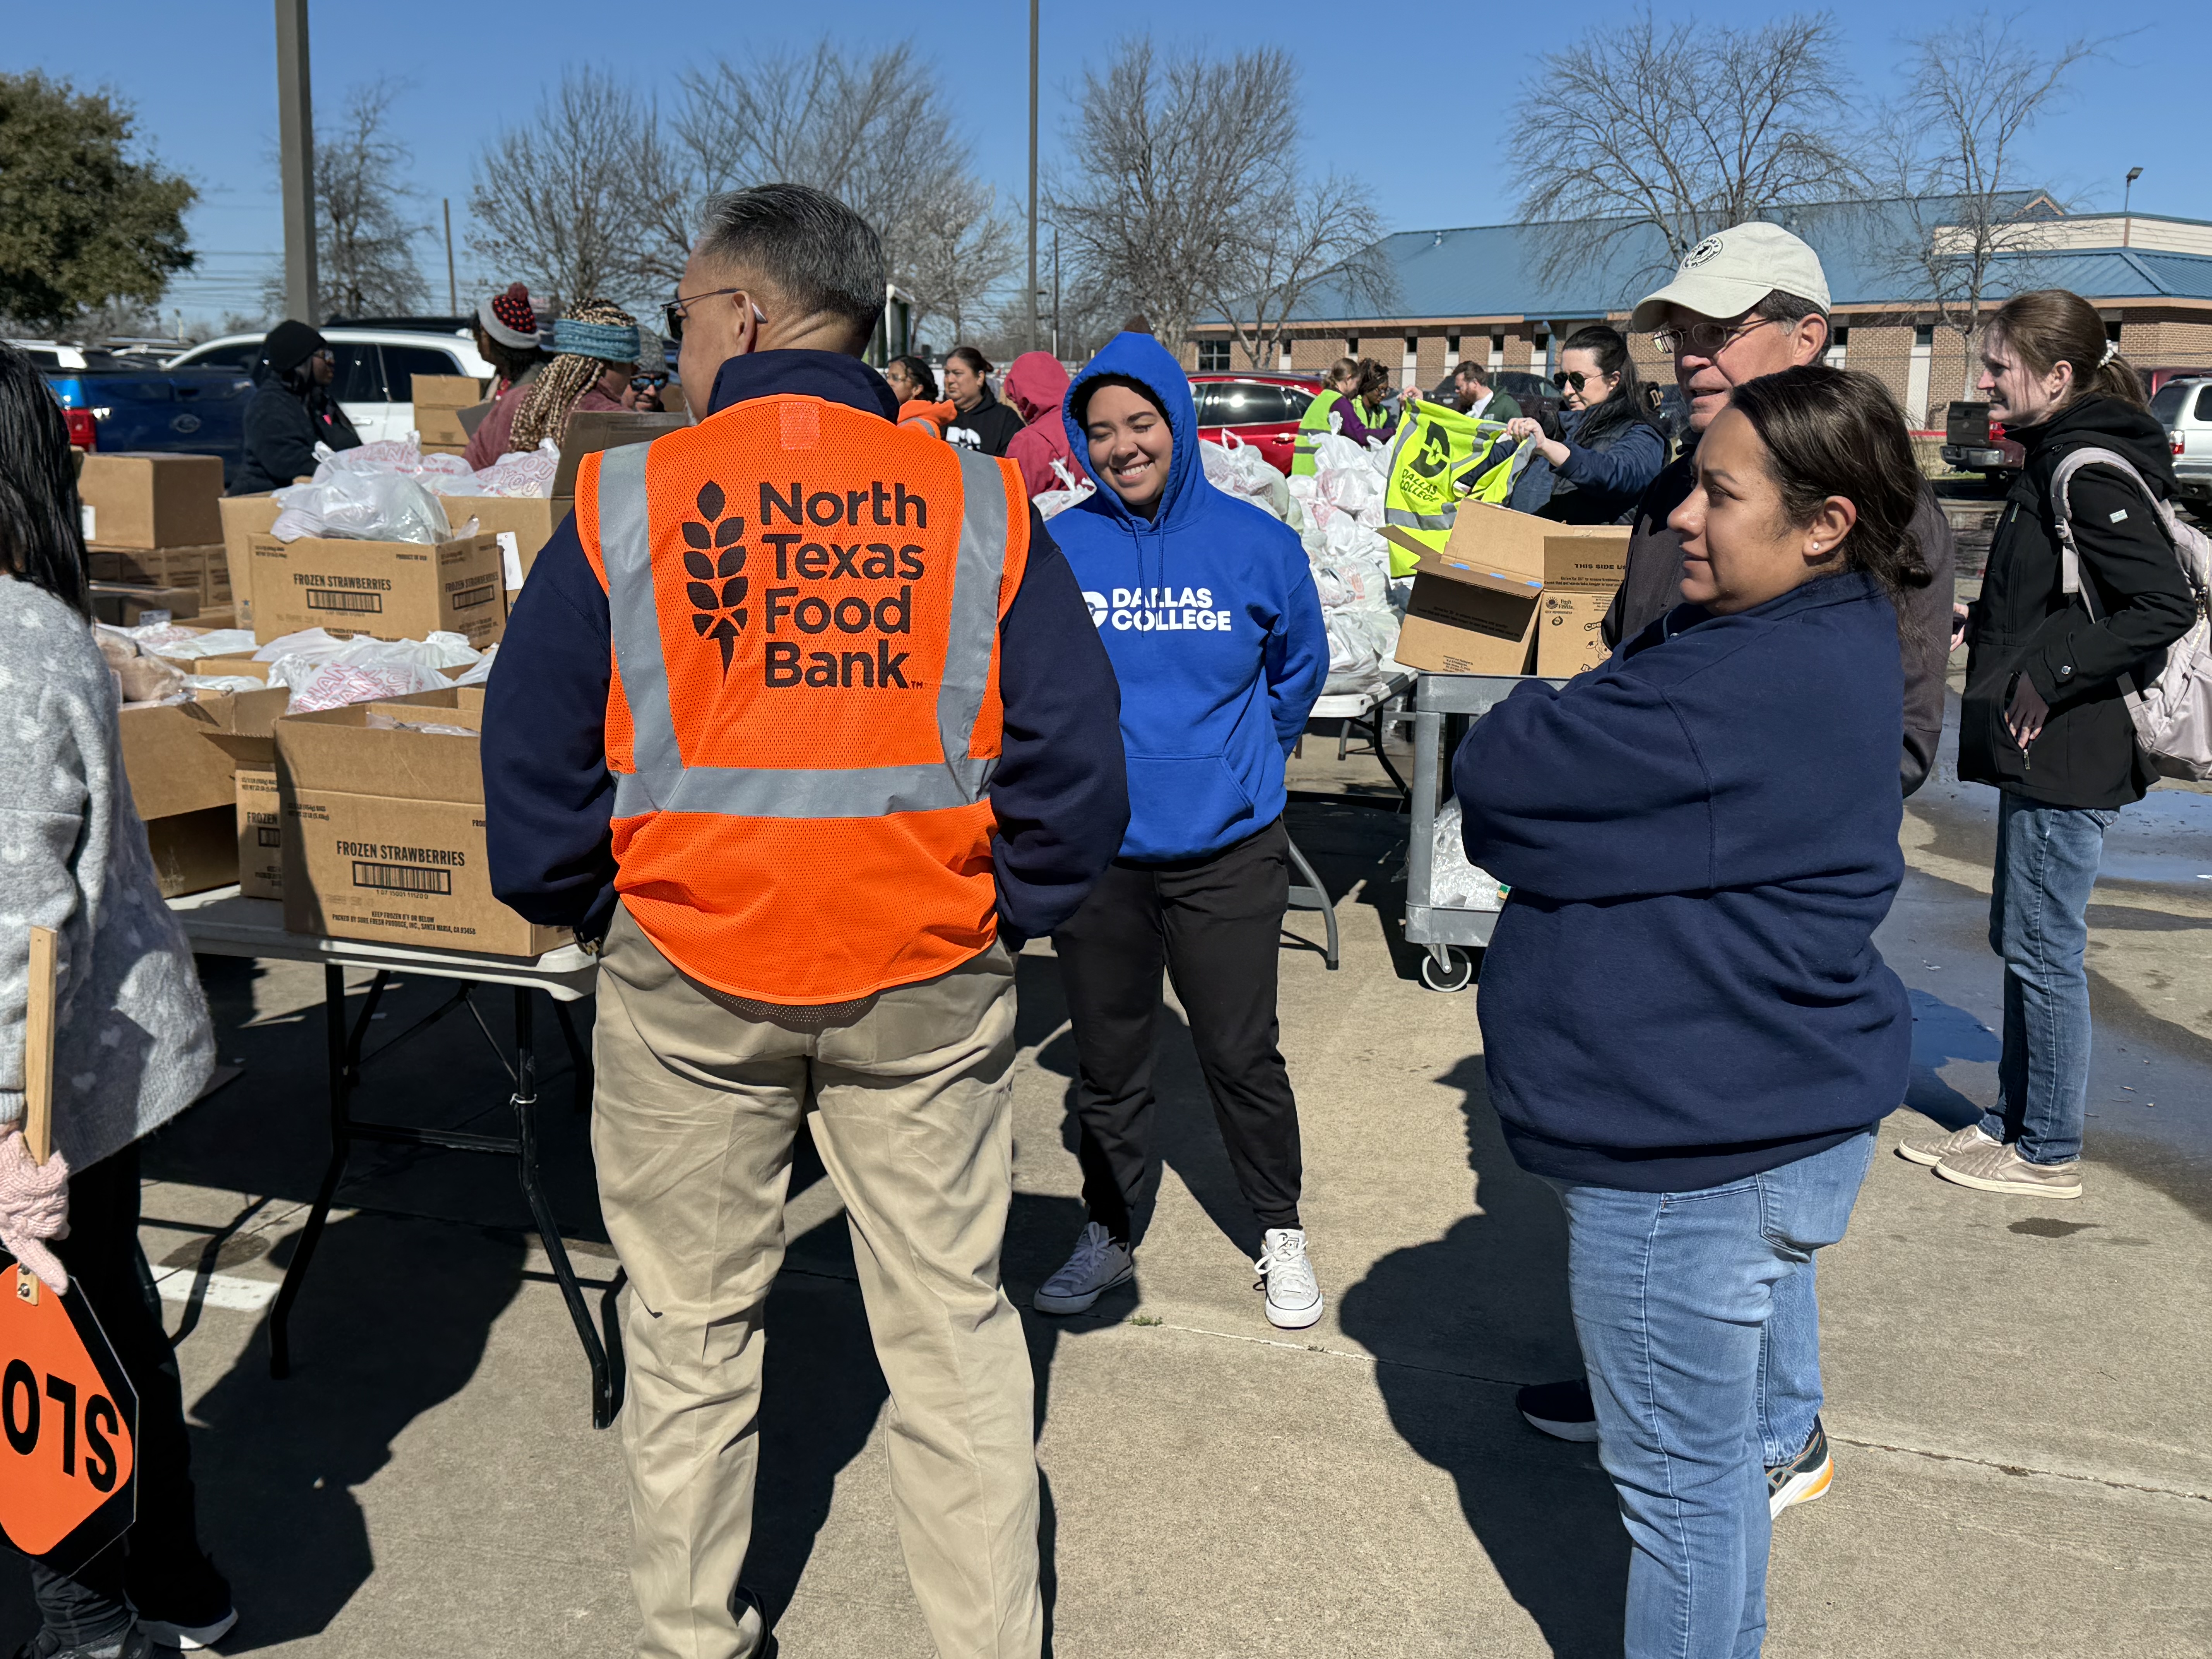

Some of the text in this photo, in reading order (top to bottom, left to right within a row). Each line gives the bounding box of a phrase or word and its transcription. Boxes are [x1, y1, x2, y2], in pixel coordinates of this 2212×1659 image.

[1400, 479, 1439, 502] COLLEGE
[1401, 469, 1438, 495] DALLAS
[759, 481, 927, 529] North
[762, 534, 925, 580] Texas
[293, 573, 392, 591] FROZEN STRAWBERRIES
[445, 580, 465, 593] FROZEN
[765, 585, 911, 634] Food
[1112, 587, 1212, 608] DALLAS
[1111, 610, 1231, 631] COLLEGE
[764, 639, 910, 689] Bank
[247, 812, 278, 824] FROZEN
[336, 840, 465, 866] FROZEN STRAWBERRIES
